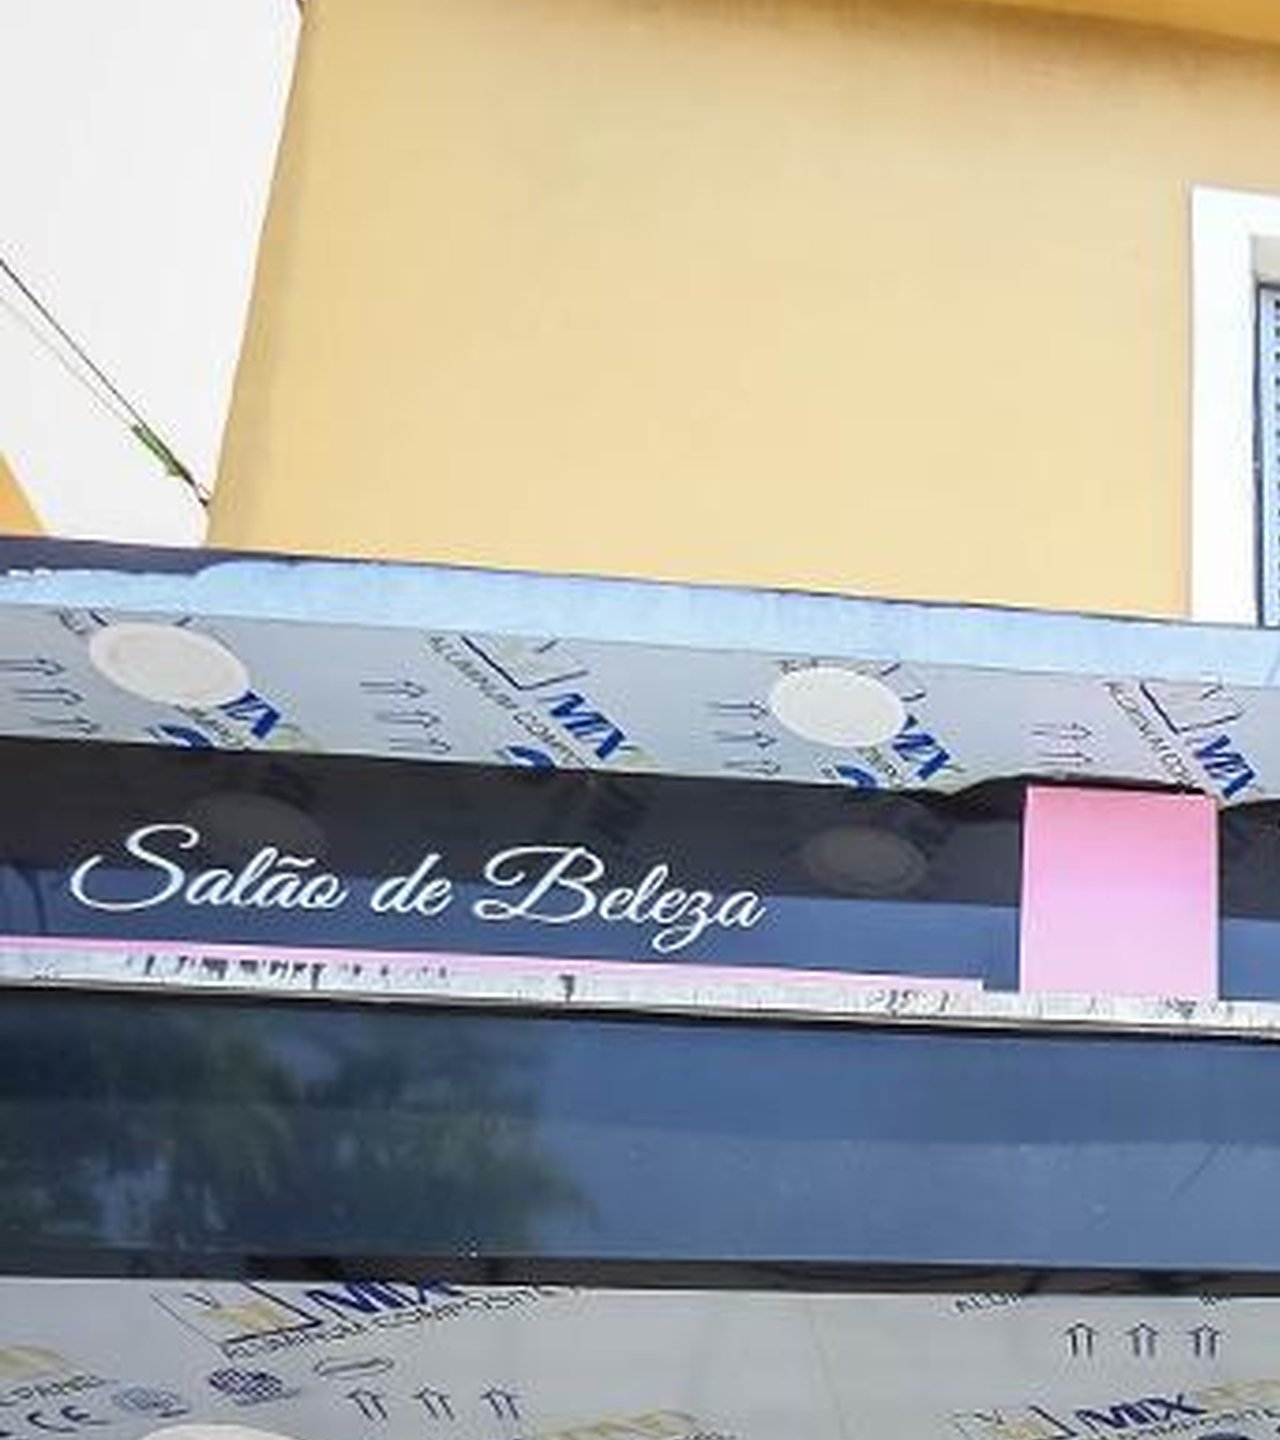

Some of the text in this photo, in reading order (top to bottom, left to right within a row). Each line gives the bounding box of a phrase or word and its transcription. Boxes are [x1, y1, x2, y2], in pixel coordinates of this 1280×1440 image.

[69, 822, 766, 953] Salão de Beleza
[1076, 1392, 1208, 1431] MIX
